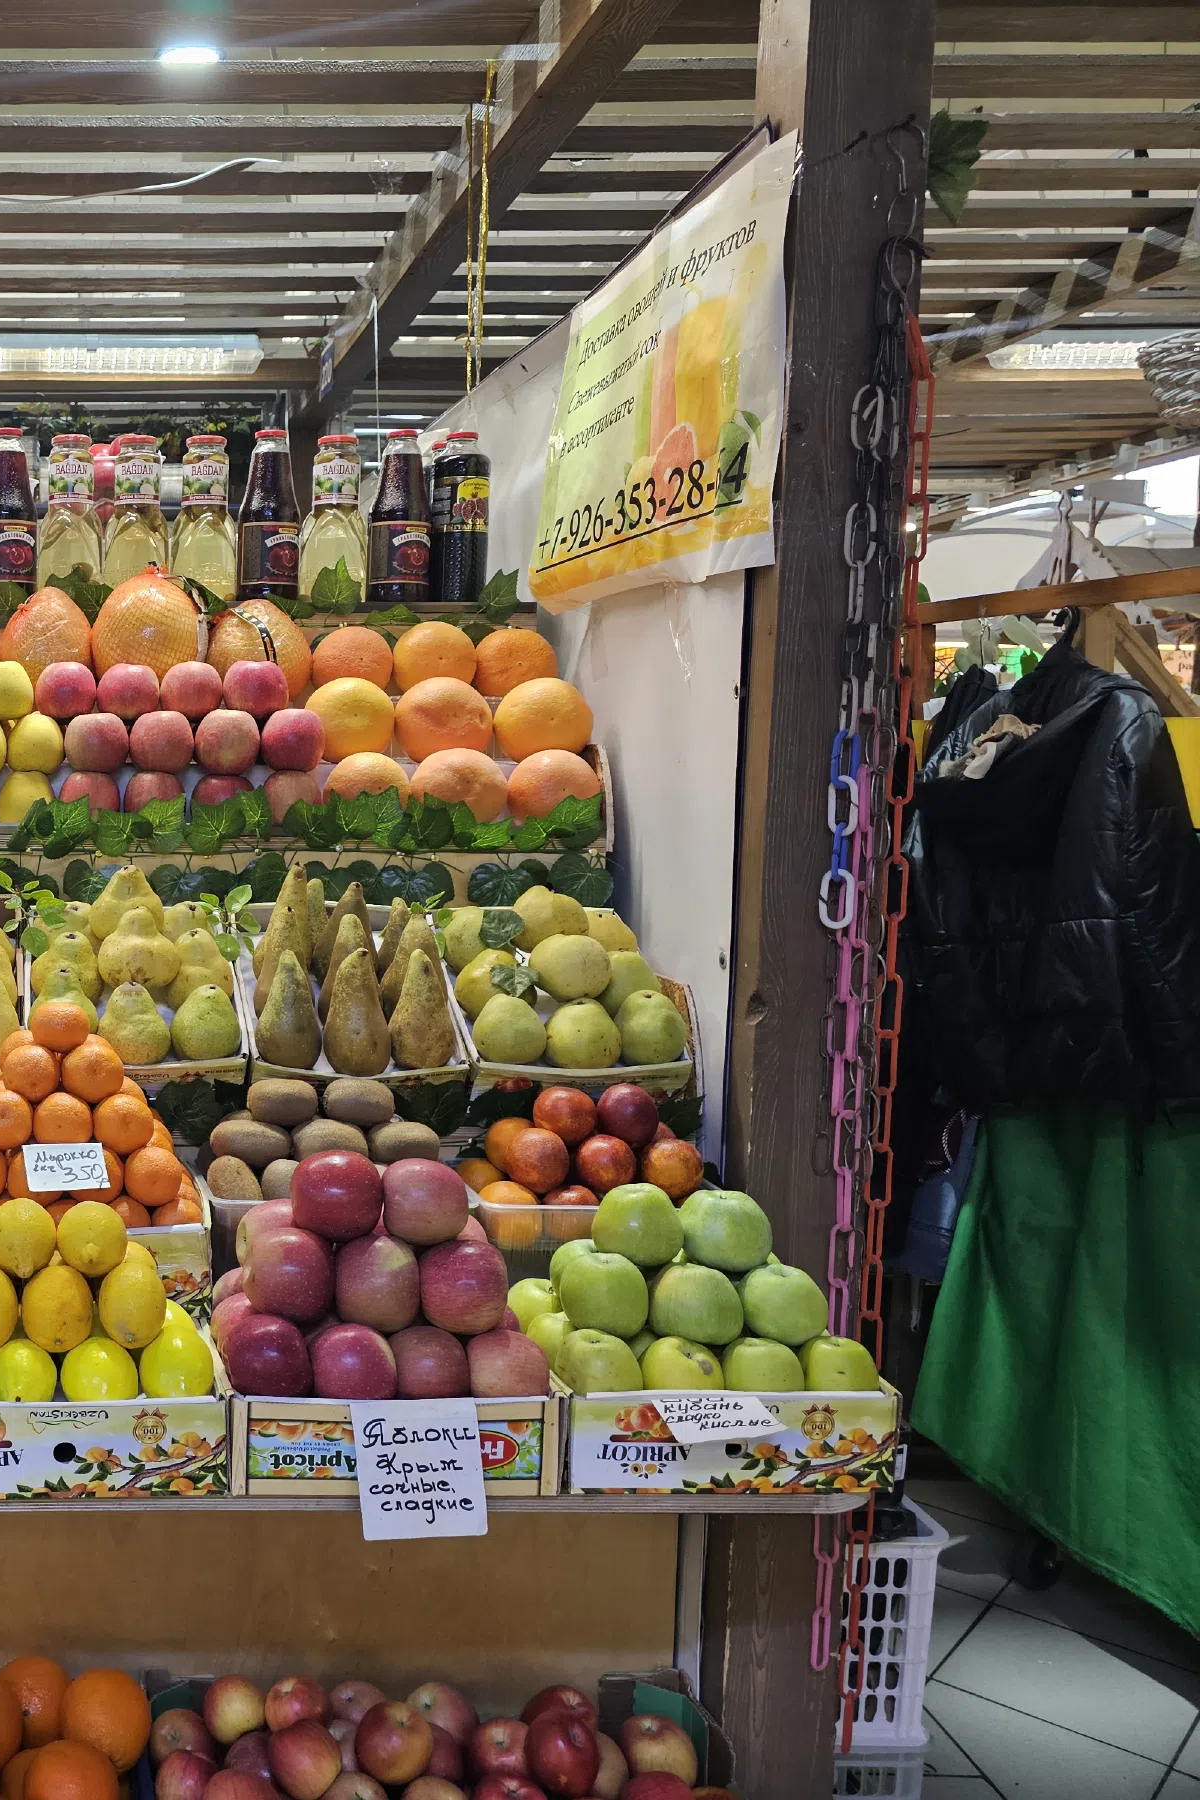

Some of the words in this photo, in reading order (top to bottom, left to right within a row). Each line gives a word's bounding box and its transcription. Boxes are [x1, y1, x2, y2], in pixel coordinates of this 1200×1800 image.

[577, 314, 626, 371] Доставка
[627, 267, 668, 326] овощей
[666, 265, 679, 289] и
[680, 220, 757, 287] фруктов
[640, 330, 662, 359] сок
[567, 396, 635, 453] ассортименте
[362, 1418, 477, 1450] Яблоки
[269, 1450, 357, 1472] Apricot
[376, 1452, 463, 1483] Крым
[597, 1443, 693, 1462] APRICOT
[381, 1497, 475, 1524] сладкие
